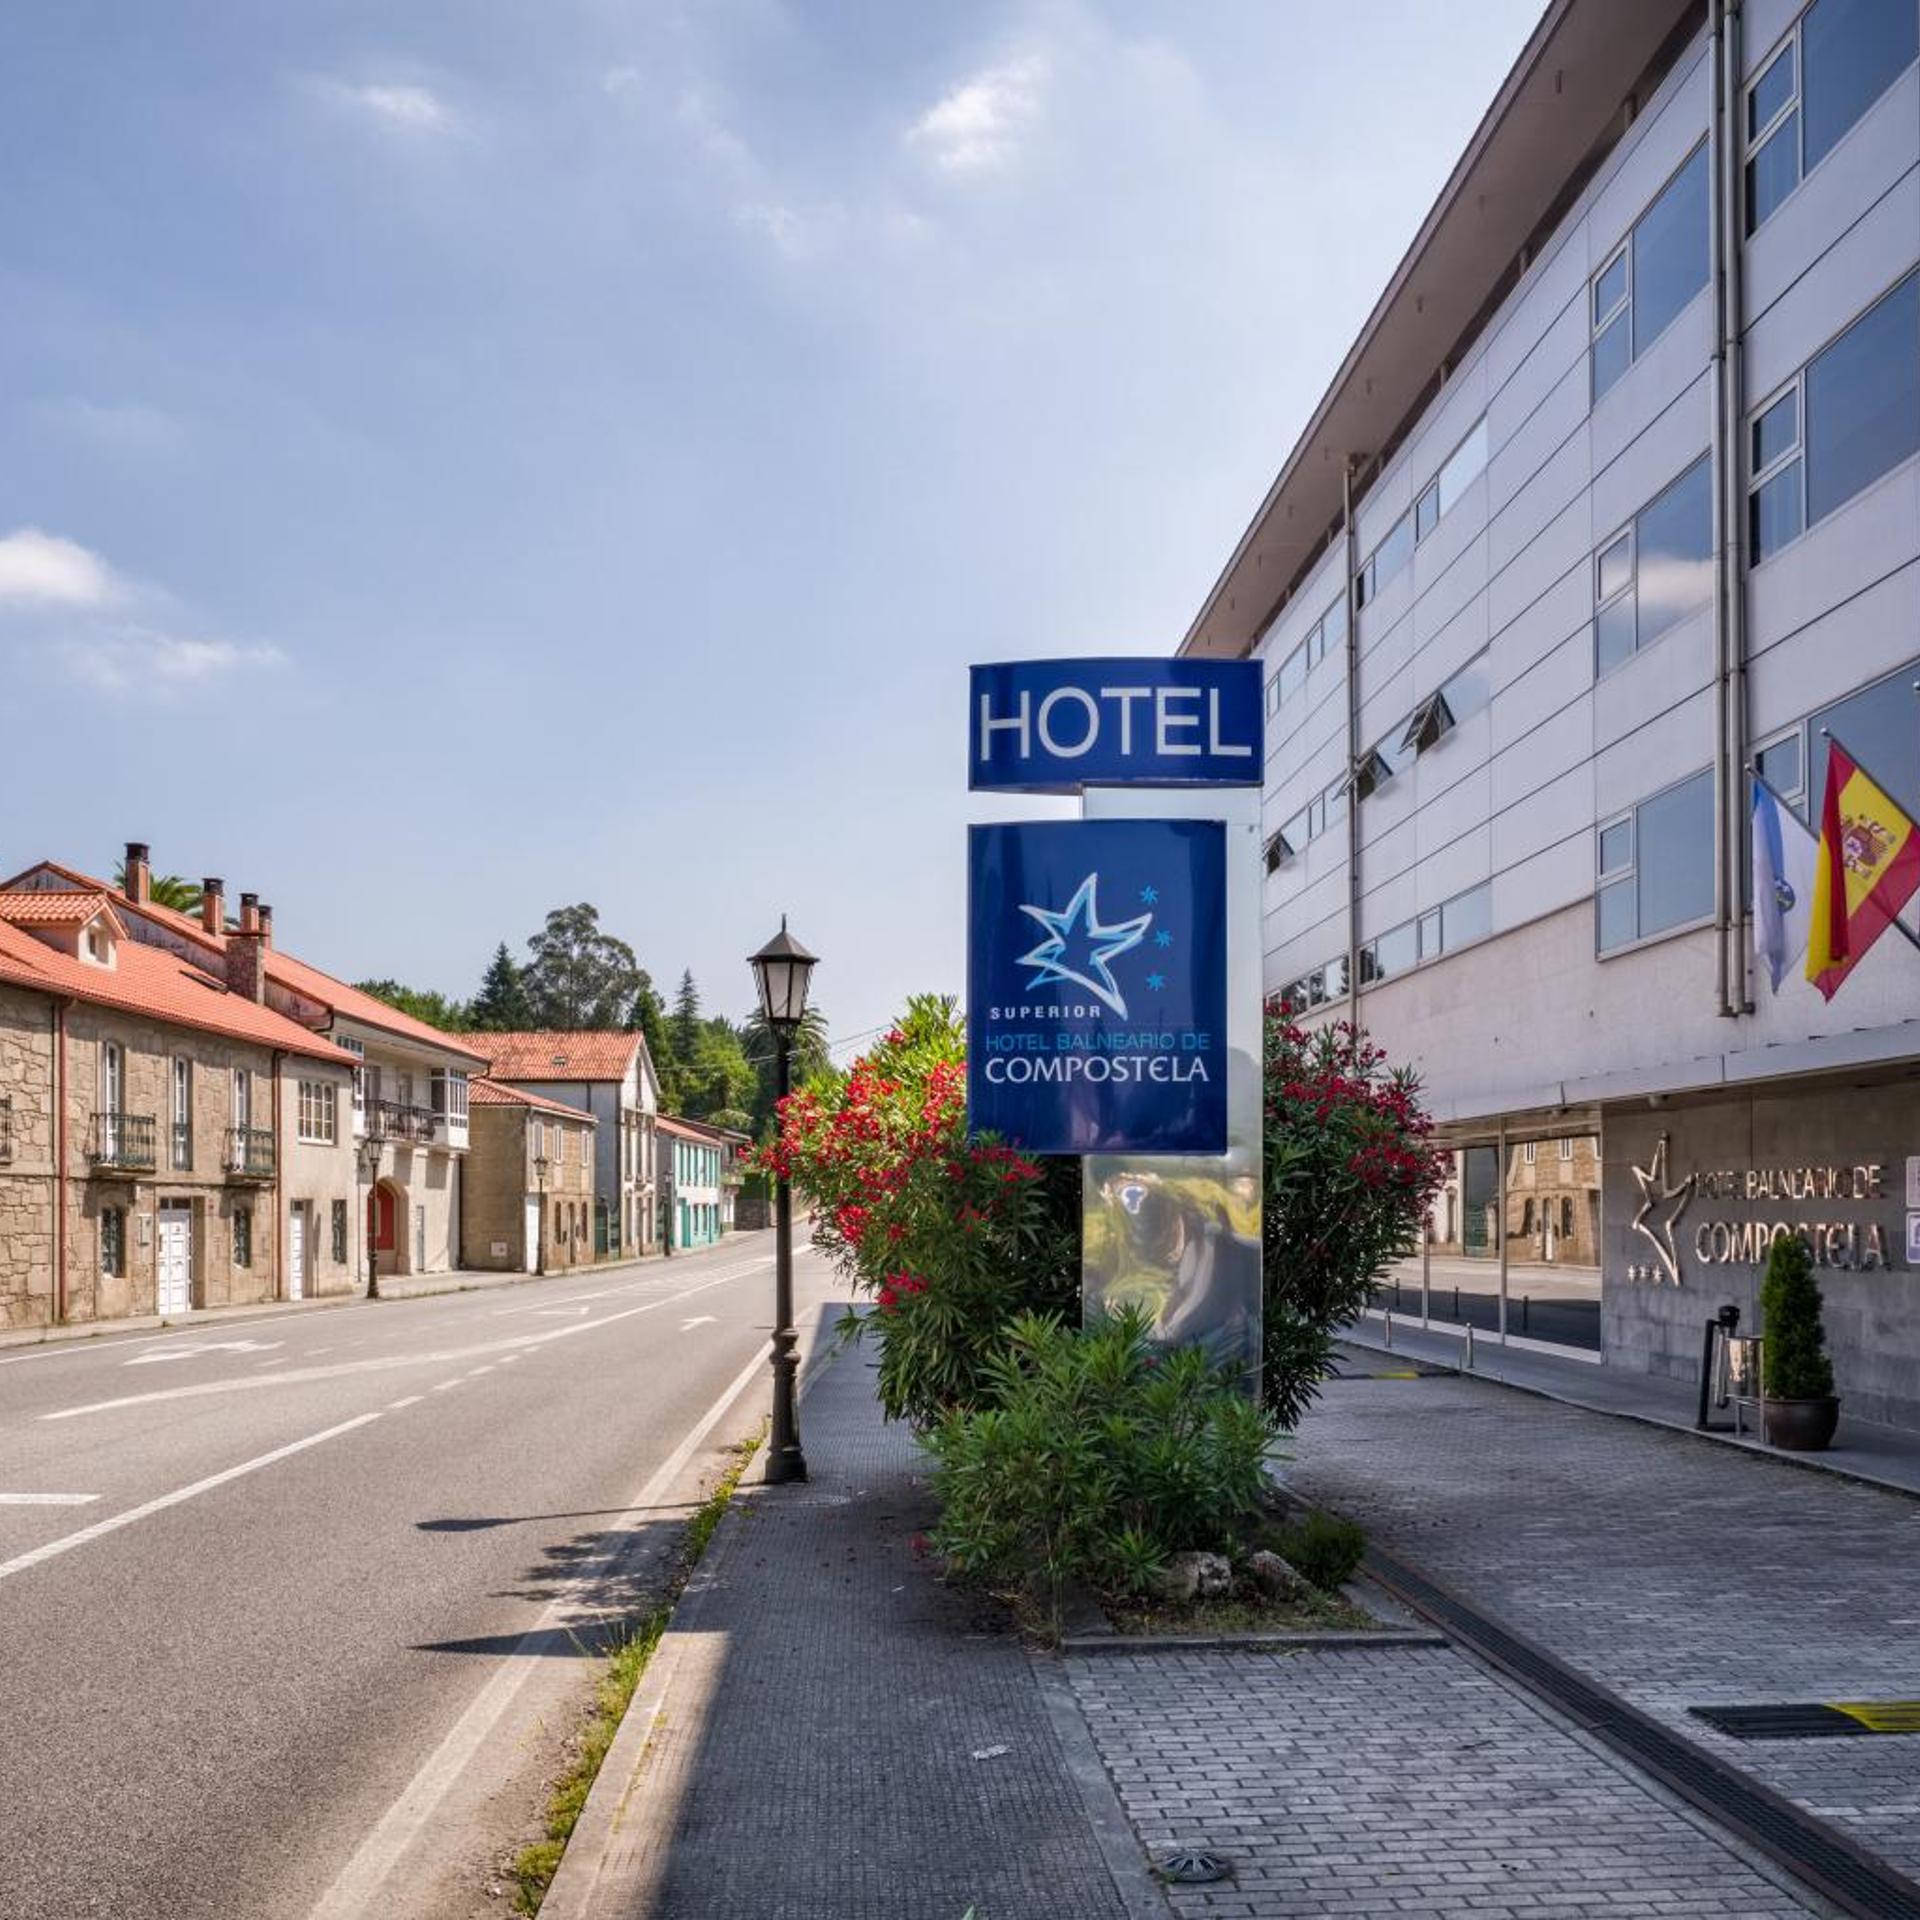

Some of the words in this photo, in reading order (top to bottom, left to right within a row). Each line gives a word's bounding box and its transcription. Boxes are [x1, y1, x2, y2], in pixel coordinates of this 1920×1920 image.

[980, 686, 1252, 761] HOTEL
[990, 1005, 1101, 1020] SUPERIOR
[985, 1033, 1050, 1052] HOTEL
[1056, 1033, 1175, 1051] BALNEARIO
[1181, 1033, 1211, 1050] DE
[985, 1056, 1210, 1083] COMPOSTELA
[1853, 1164, 1881, 1199] DE
